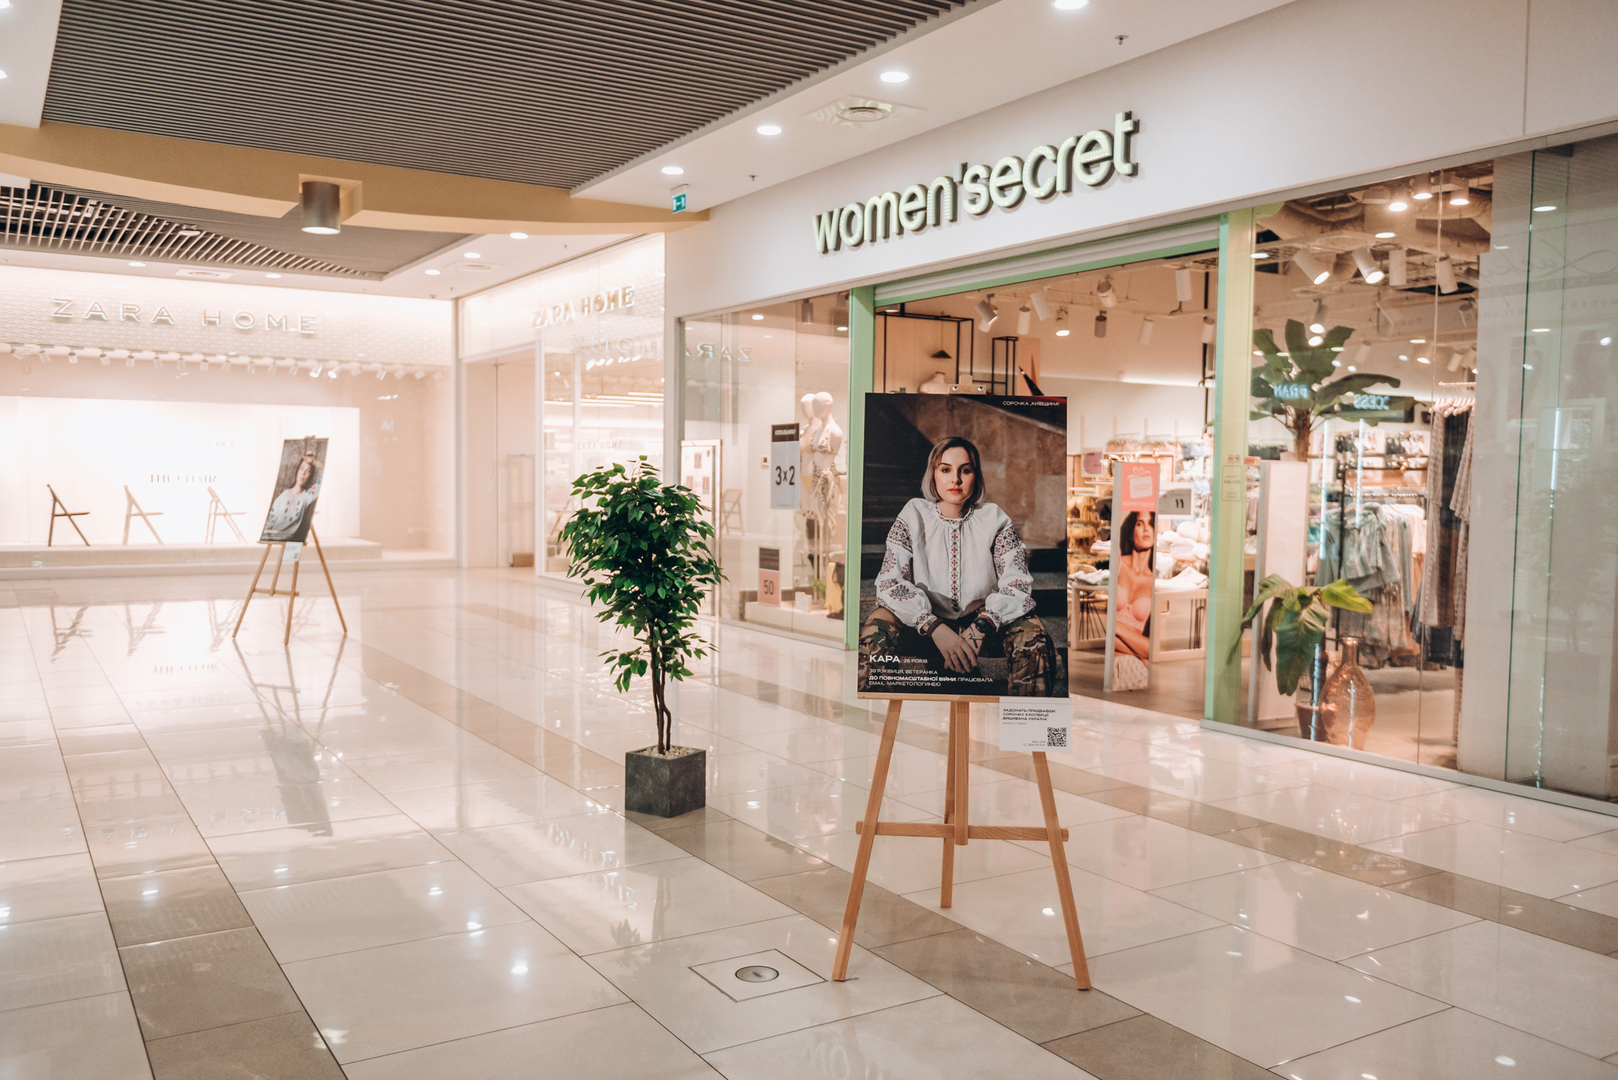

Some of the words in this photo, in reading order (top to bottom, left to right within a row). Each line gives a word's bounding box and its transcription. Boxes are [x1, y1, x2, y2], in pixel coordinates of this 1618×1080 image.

[51, 298, 176, 325] ZARA
[202, 309, 318, 334] HOME
[532, 301, 576, 329] ZARA
[581, 285, 635, 316] HOME
[869, 654, 901, 663] КАРА
